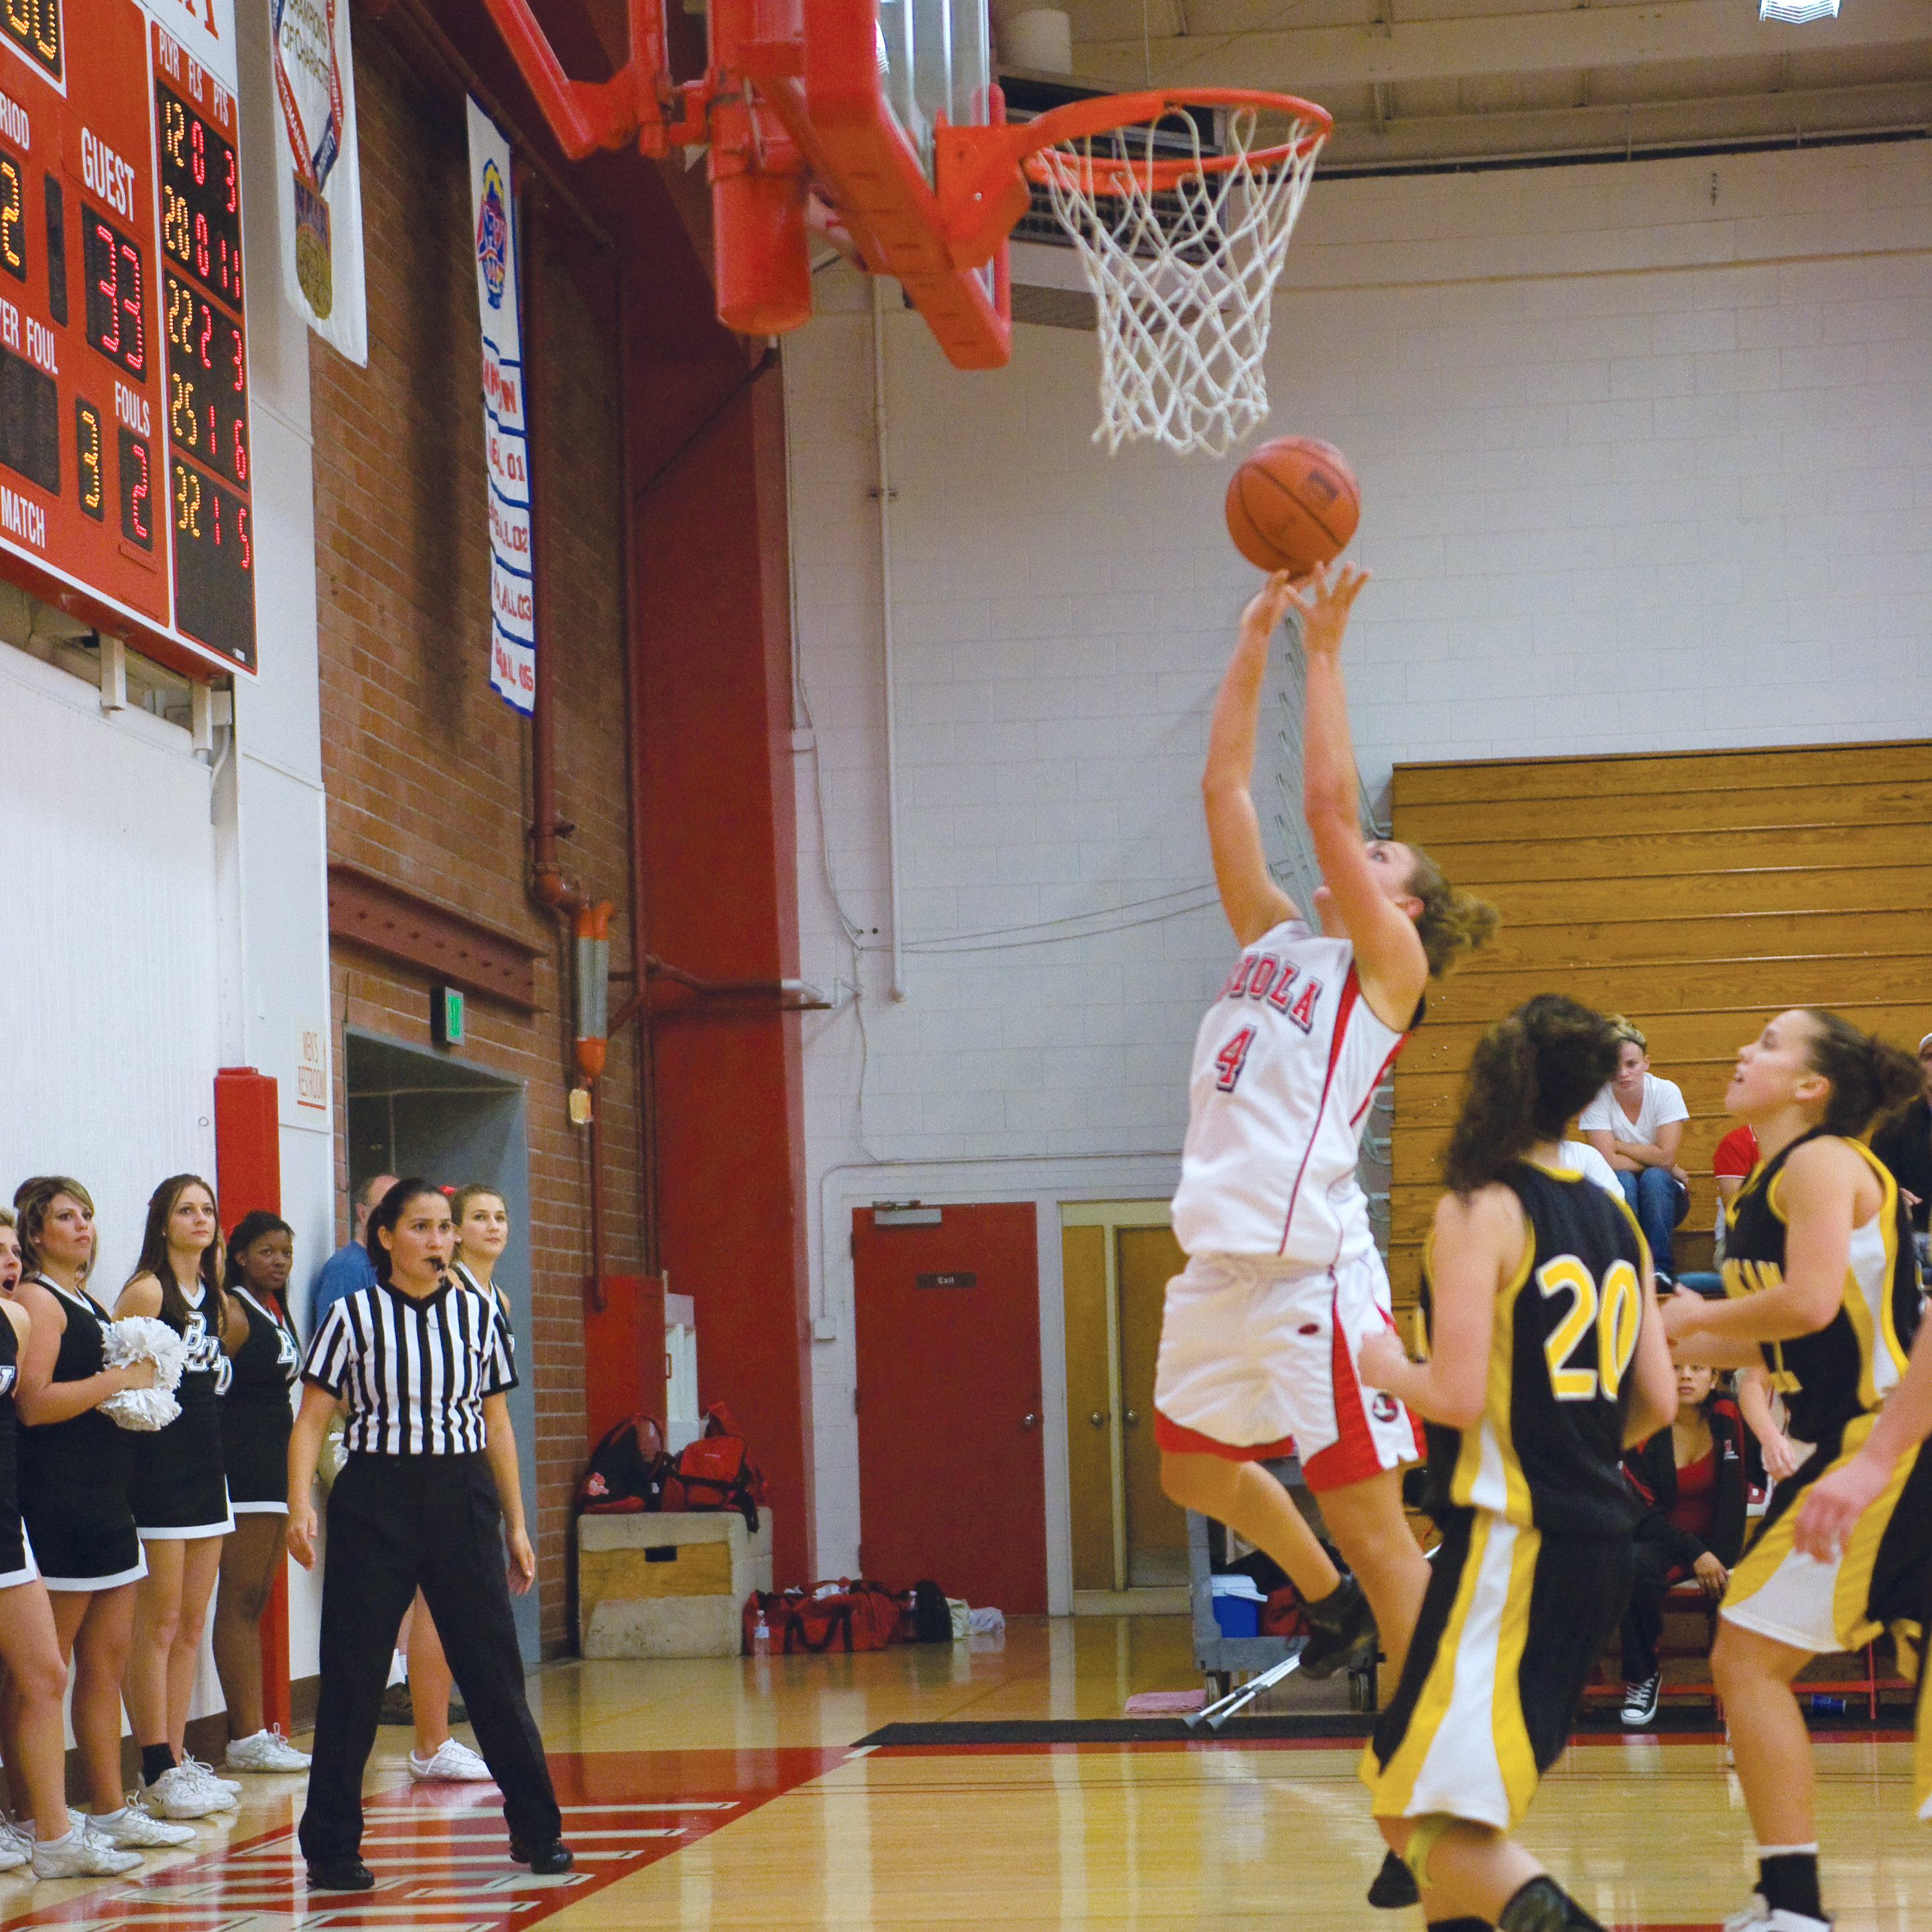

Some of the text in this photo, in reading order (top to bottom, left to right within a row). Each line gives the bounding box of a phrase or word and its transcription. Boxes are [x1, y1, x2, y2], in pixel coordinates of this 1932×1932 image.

[159, 27, 229, 127] PLYR FLS PTS
[81, 127, 134, 222] GUEST
[166, 101, 184, 167] 12
[225, 150, 235, 212] 3
[1, 162, 20, 267] 2
[96, 224, 142, 369] 33
[222, 239, 240, 298] 11
[0, 297, 58, 375] ER FOUL
[169, 279, 243, 391] 22 2 3
[115, 381, 150, 438] FOULS
[173, 373, 246, 480] 25 1 6
[82, 410, 148, 538] 3 2
[507, 452, 525, 482] 01
[1, 485, 46, 550] MATCH
[176, 466, 250, 569] 32 1 5
[1216, 1023, 1257, 1093] 4
[938, 1276, 954, 1284] Exit
[1536, 1254, 1642, 1403] 20
